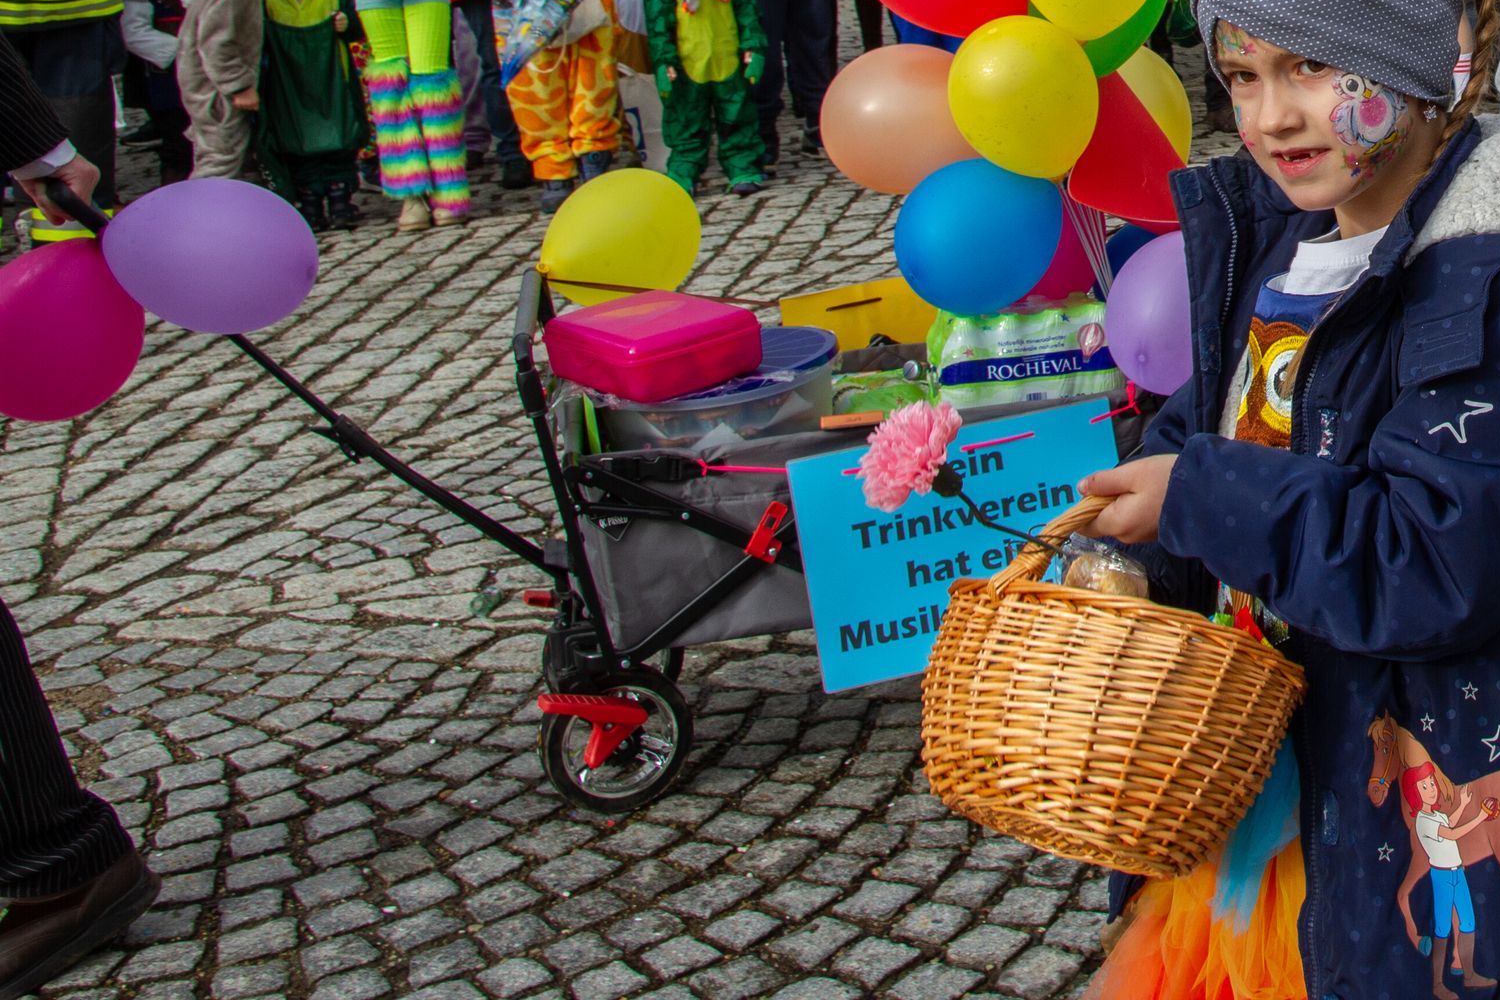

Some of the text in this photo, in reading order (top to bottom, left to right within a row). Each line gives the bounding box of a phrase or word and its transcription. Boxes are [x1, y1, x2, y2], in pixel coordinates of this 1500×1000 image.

[987, 356, 1083, 380] ROCHEVAL
[949, 448, 1005, 478] ein
[851, 480, 1075, 550] Trinkverein
[906, 538, 1028, 588] hat ei
